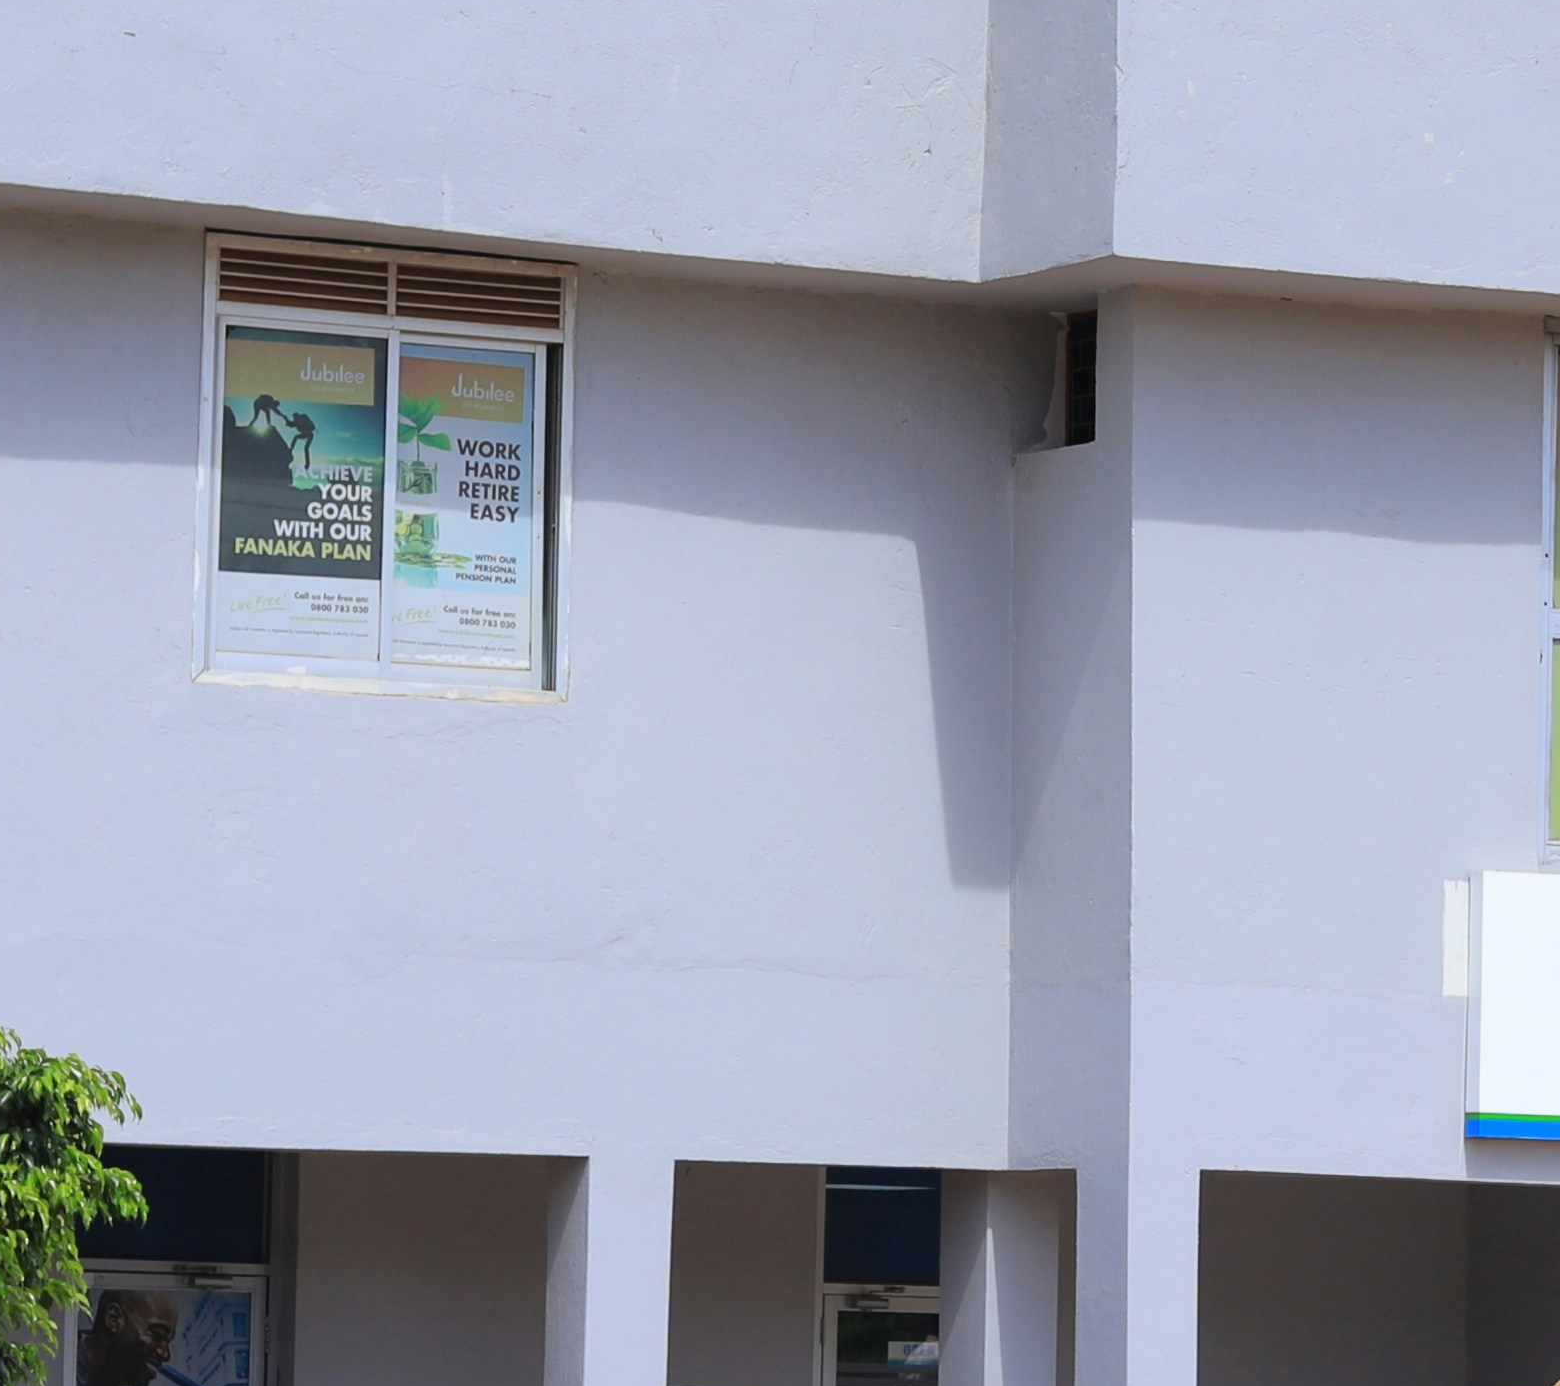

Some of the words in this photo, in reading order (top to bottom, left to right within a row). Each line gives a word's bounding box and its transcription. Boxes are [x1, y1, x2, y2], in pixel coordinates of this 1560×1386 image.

[300, 356, 365, 384] Jubilee
[451, 372, 515, 402] Jubilee
[457, 438, 522, 461] WORK
[294, 465, 373, 483] ACHIEVE
[465, 460, 521, 481] HARD
[318, 483, 372, 502] YOUR
[458, 481, 520, 502] RETIRE
[307, 502, 372, 522] GOALS
[470, 503, 520, 523] EASY
[274, 519, 324, 539] WITH
[330, 523, 372, 542] OUR
[235, 537, 315, 558] FANAKA
[321, 542, 371, 561] PLAN
[475, 554, 497, 563] WITH
[499, 556, 517, 564] OUR
[455, 572, 492, 583] PENSION
[494, 576, 516, 585] PLAN
[474, 564, 517, 574] PERSONAL
[294, 592, 309, 600] Call
[323, 593, 335, 602] for
[337, 593, 353, 602] free
[311, 603, 332, 612] 0800
[334, 604, 350, 613] 783
[352, 605, 369, 614] 030
[443, 605, 458, 613] Call
[471, 607, 483, 616] for
[485, 608, 501, 617] free
[459, 617, 480, 626] 0800
[482, 619, 498, 628] 783
[500, 620, 516, 629] 030
